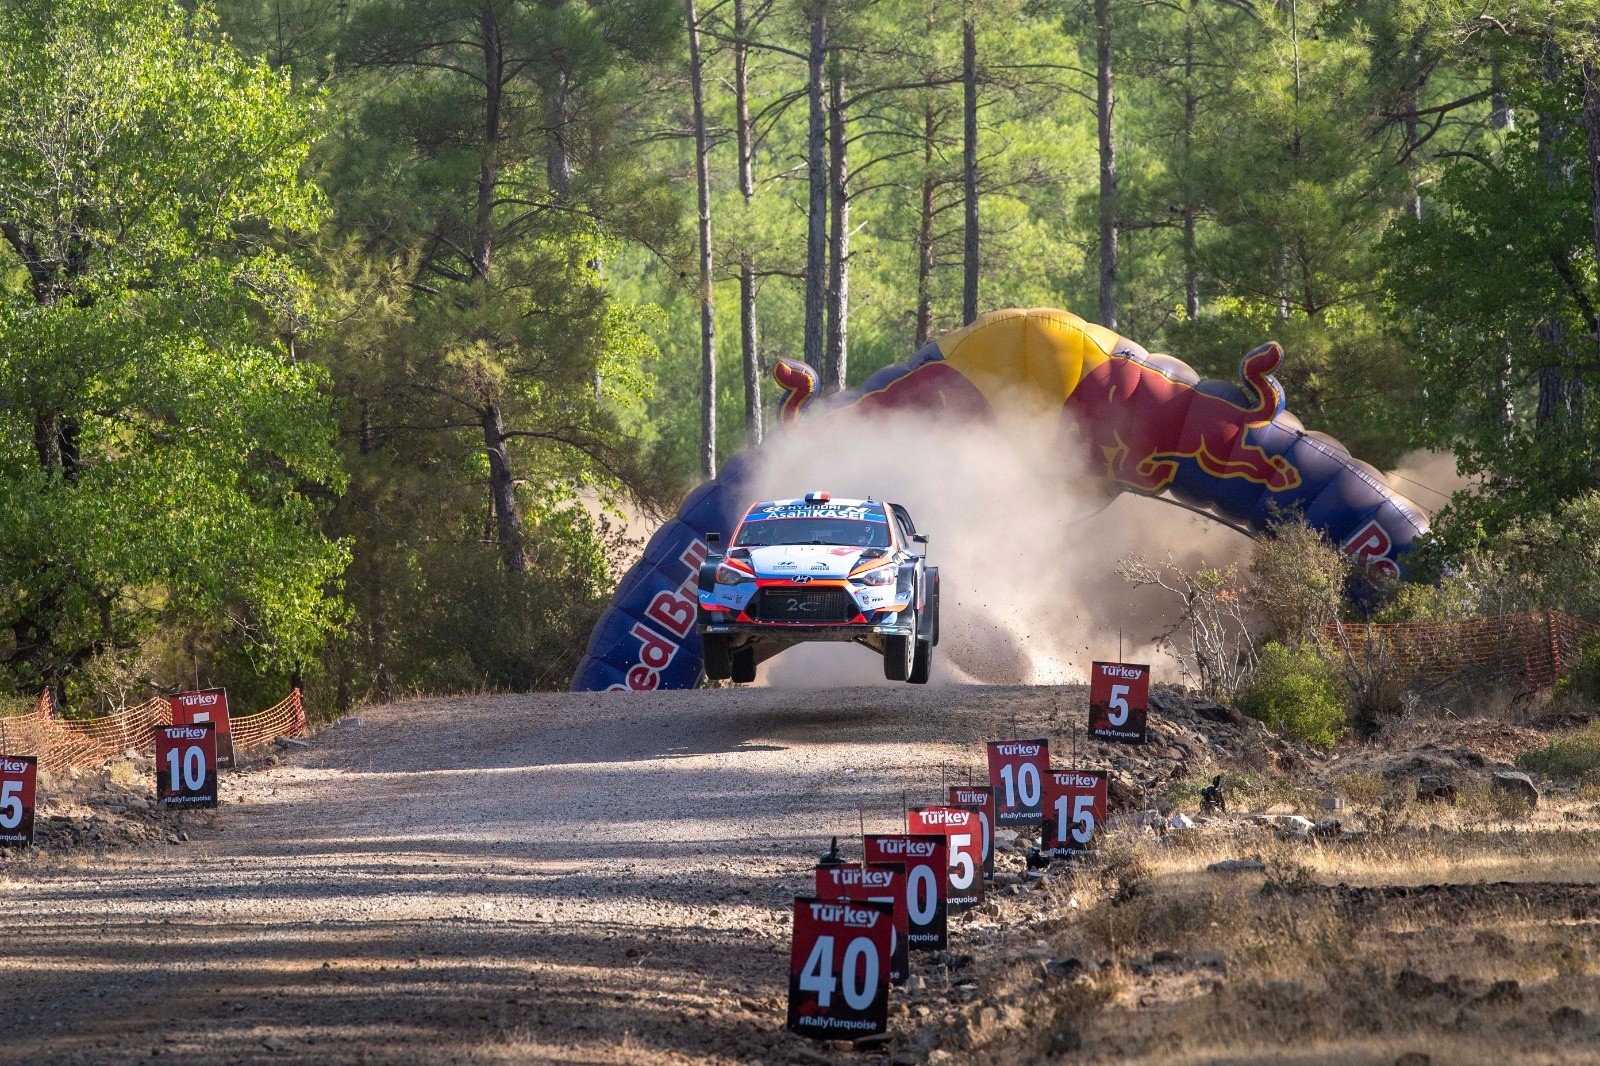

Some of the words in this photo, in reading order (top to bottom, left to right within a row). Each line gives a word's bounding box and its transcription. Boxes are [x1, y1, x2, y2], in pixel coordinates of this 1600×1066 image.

[607, 622, 679, 691] ed
[1102, 665, 1142, 680] Turkey
[178, 694, 218, 706] Turkey
[1108, 684, 1130, 726] 5
[165, 727, 207, 740] Turkey
[1095, 729, 1140, 738] #RallyTurquoise
[997, 744, 1040, 756] Turkey
[0, 759, 28, 774] rkey
[166, 745, 206, 791] 10
[1000, 762, 1041, 807] 10
[1053, 773, 1098, 788] Turkey
[0, 780, 24, 829] 5
[164, 795, 212, 803] #RallyTurquoise
[956, 790, 988, 805] Turkey
[919, 811, 970, 825] Turkey
[1000, 812, 1043, 820] #RallyTurquoi
[1054, 795, 1095, 844] 15
[877, 839, 936, 857] Turkey
[949, 833, 975, 890] 5
[829, 868, 894, 887] Turkey
[907, 864, 938, 926] 0
[947, 896, 978, 904] urquoise
[809, 903, 880, 928] Turkey
[799, 935, 880, 1011] 40
[799, 1016, 877, 1030] #RallyTurquoise
